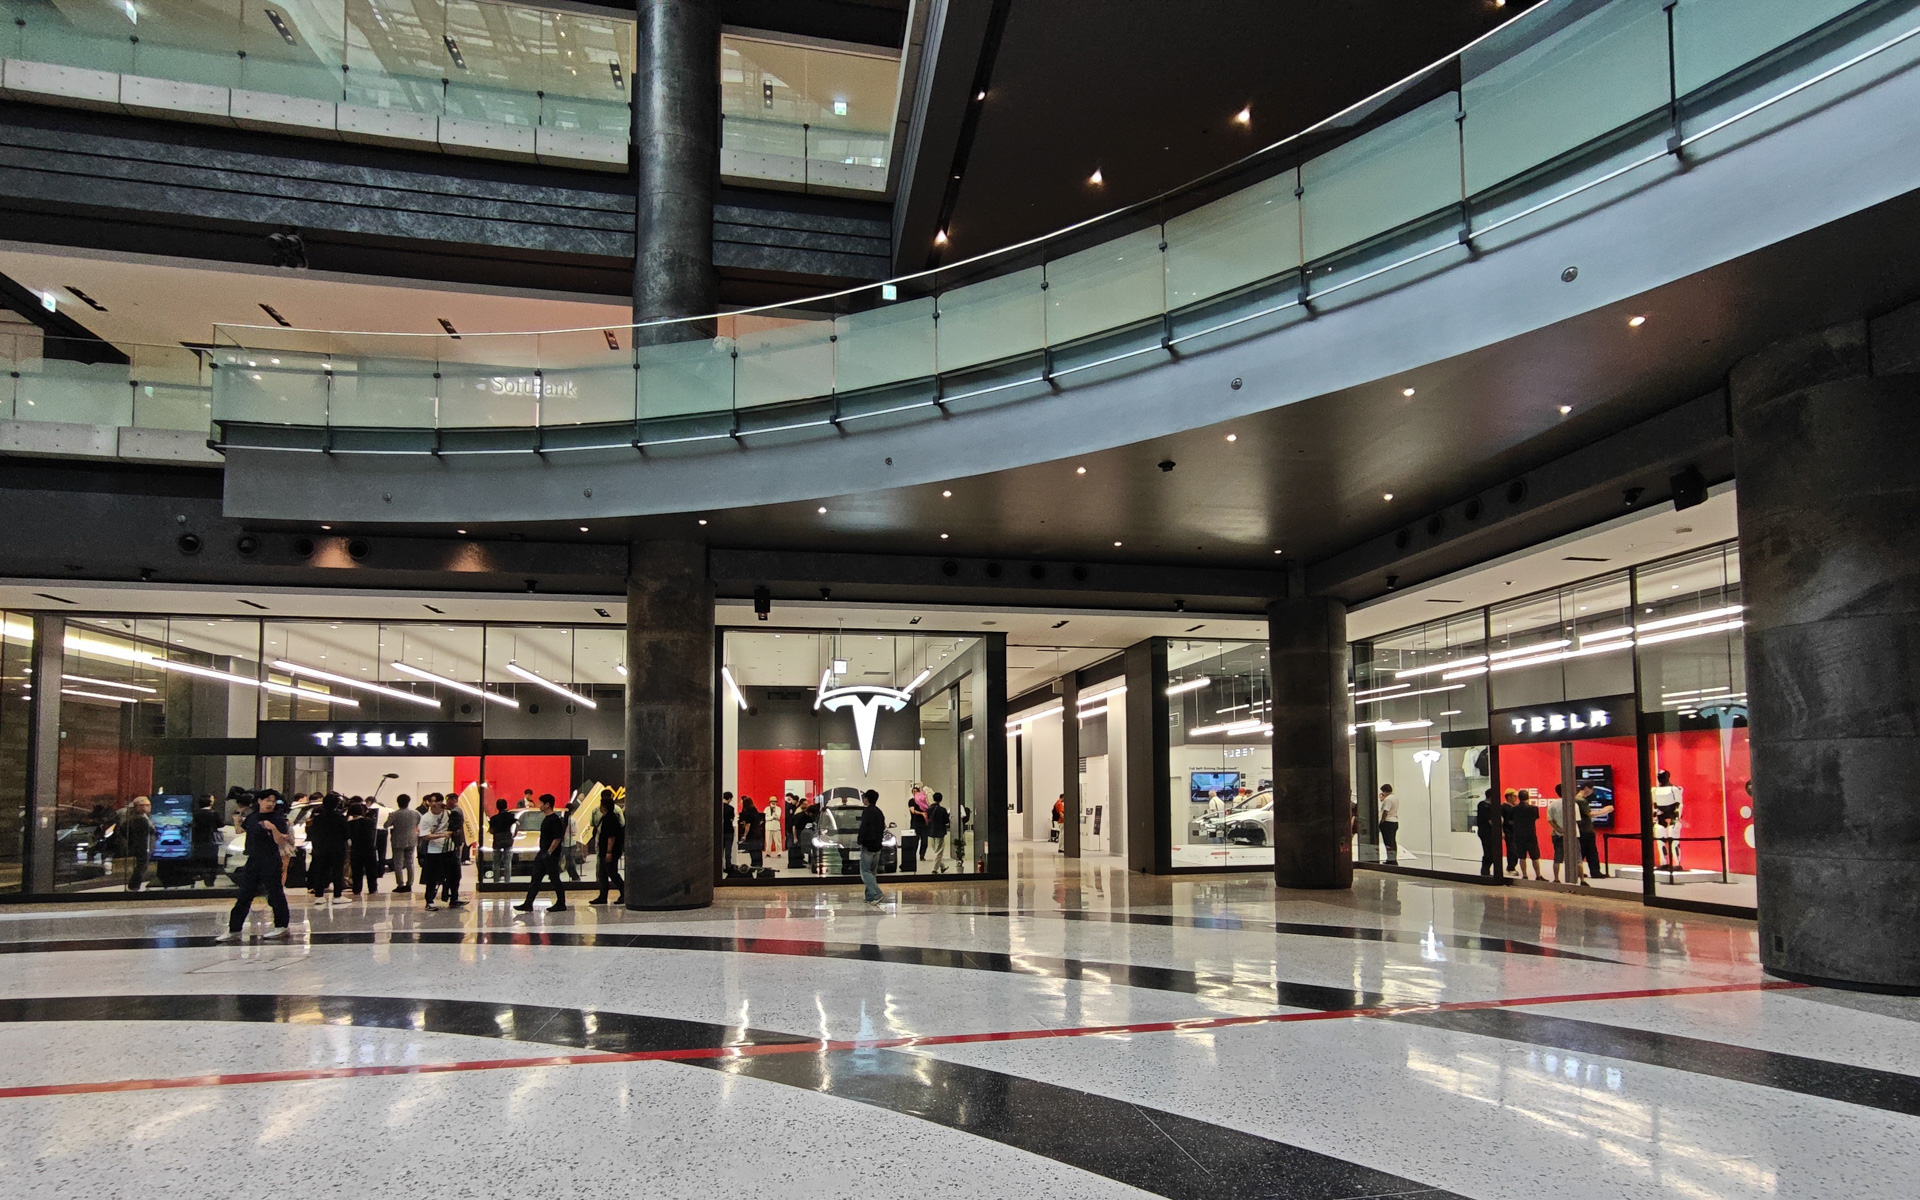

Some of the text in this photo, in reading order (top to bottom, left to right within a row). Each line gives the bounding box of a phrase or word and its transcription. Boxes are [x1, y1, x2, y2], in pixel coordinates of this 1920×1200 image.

[492, 377, 578, 397] SoftBank
[1511, 710, 1611, 734] TESLA
[311, 731, 429, 748] TESLA
